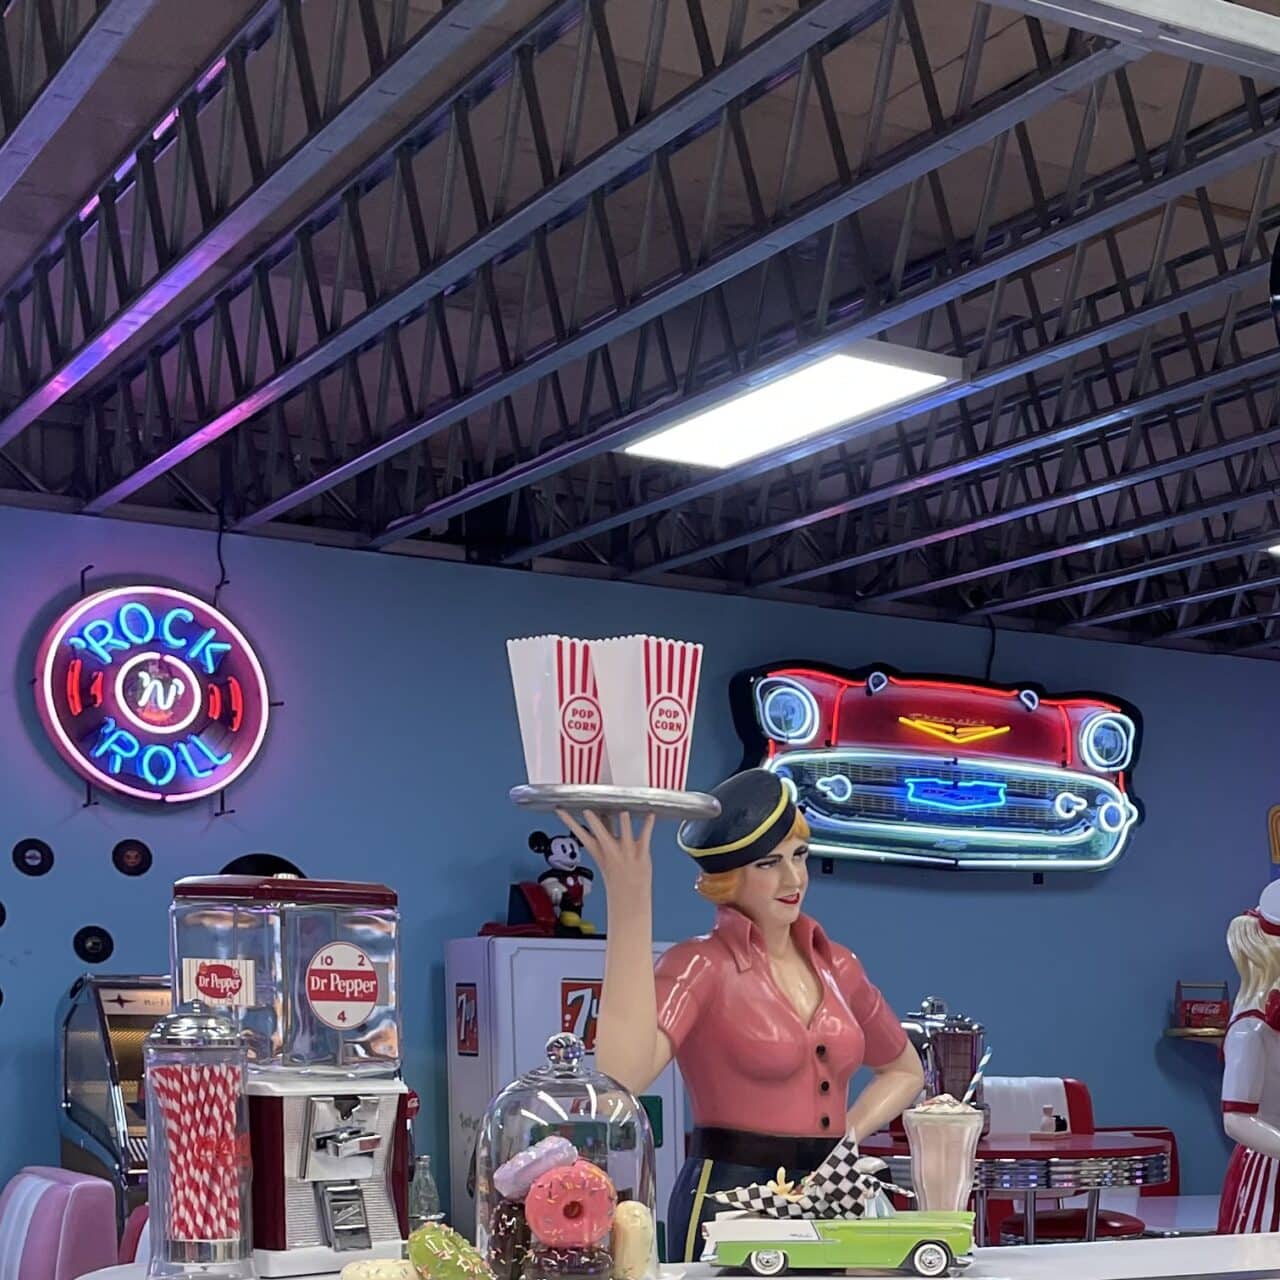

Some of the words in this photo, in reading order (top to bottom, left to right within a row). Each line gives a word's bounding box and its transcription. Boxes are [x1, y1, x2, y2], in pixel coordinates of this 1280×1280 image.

[571, 708, 594, 719] POP
[658, 708, 680, 719] POP
[567, 720, 597, 731] CORN
[654, 720, 682, 731] CORN
[319, 955, 334, 966] 10
[357, 954, 366, 967] 2
[198, 975, 210, 988] Dr
[210, 974, 242, 993] Pepper
[310, 975, 328, 991] Dr
[329, 973, 377, 998] Pepper
[336, 1010, 346, 1023] 4
